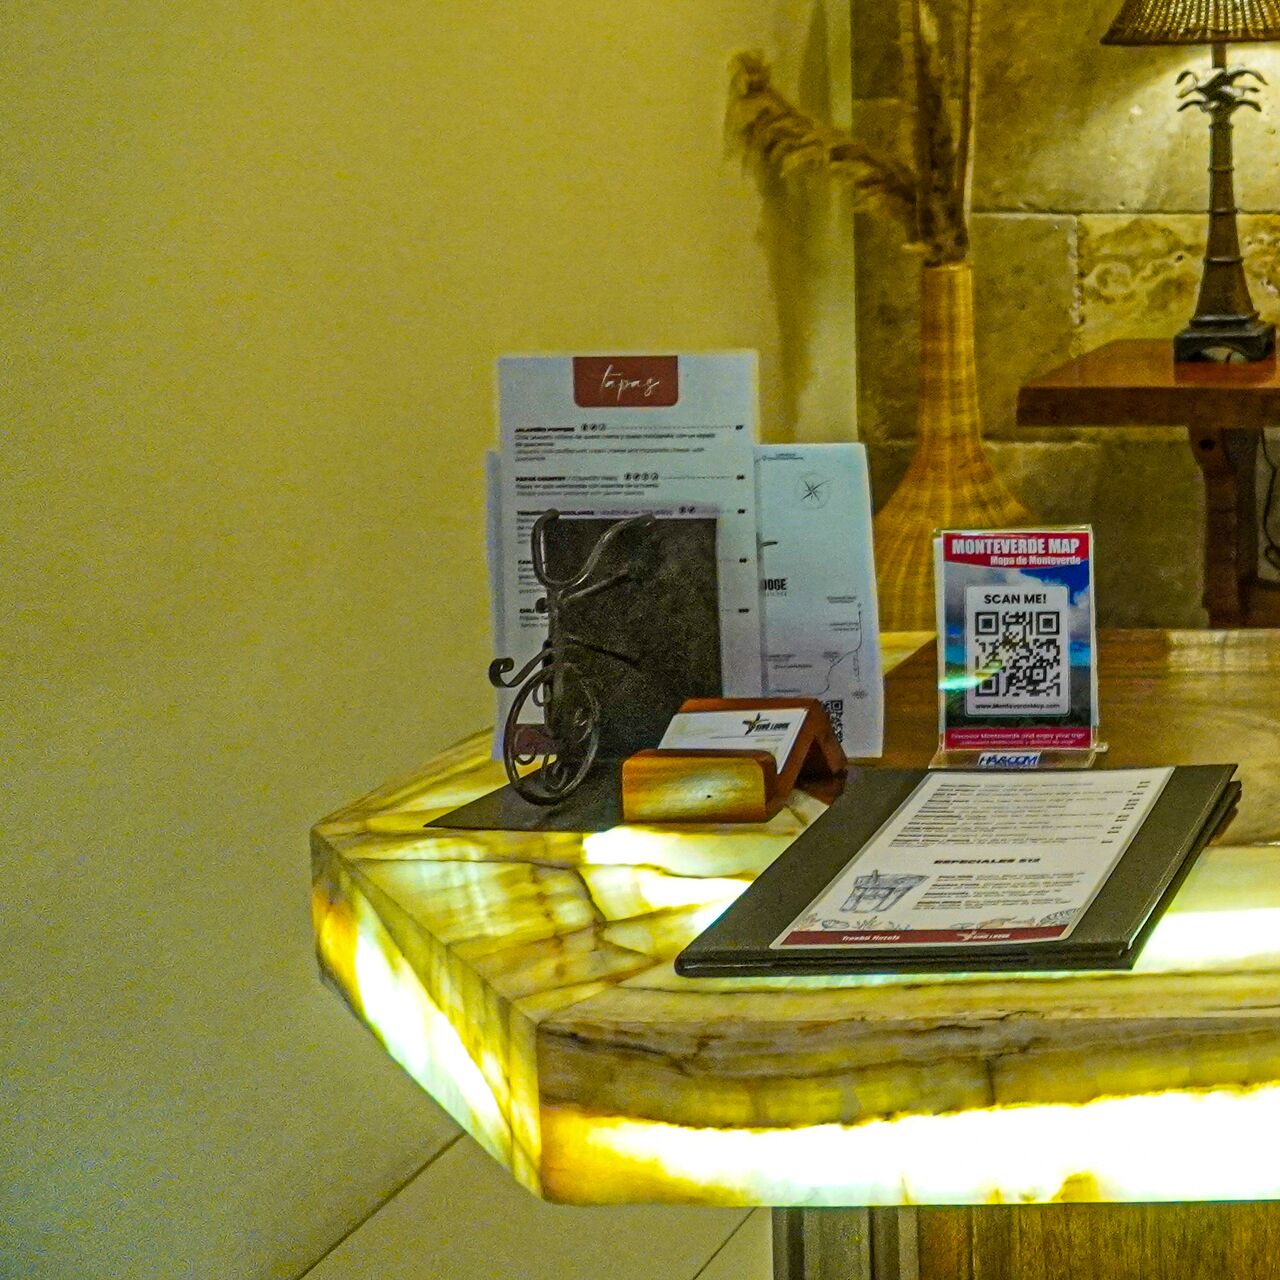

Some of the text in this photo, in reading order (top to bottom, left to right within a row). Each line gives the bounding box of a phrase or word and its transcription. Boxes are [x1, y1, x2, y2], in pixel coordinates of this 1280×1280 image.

[952, 538, 1080, 555] MONTEVERDE MAP
[990, 555, 1081, 566] Mapa de Monteverde
[984, 593, 1047, 604] SCAN ME!
